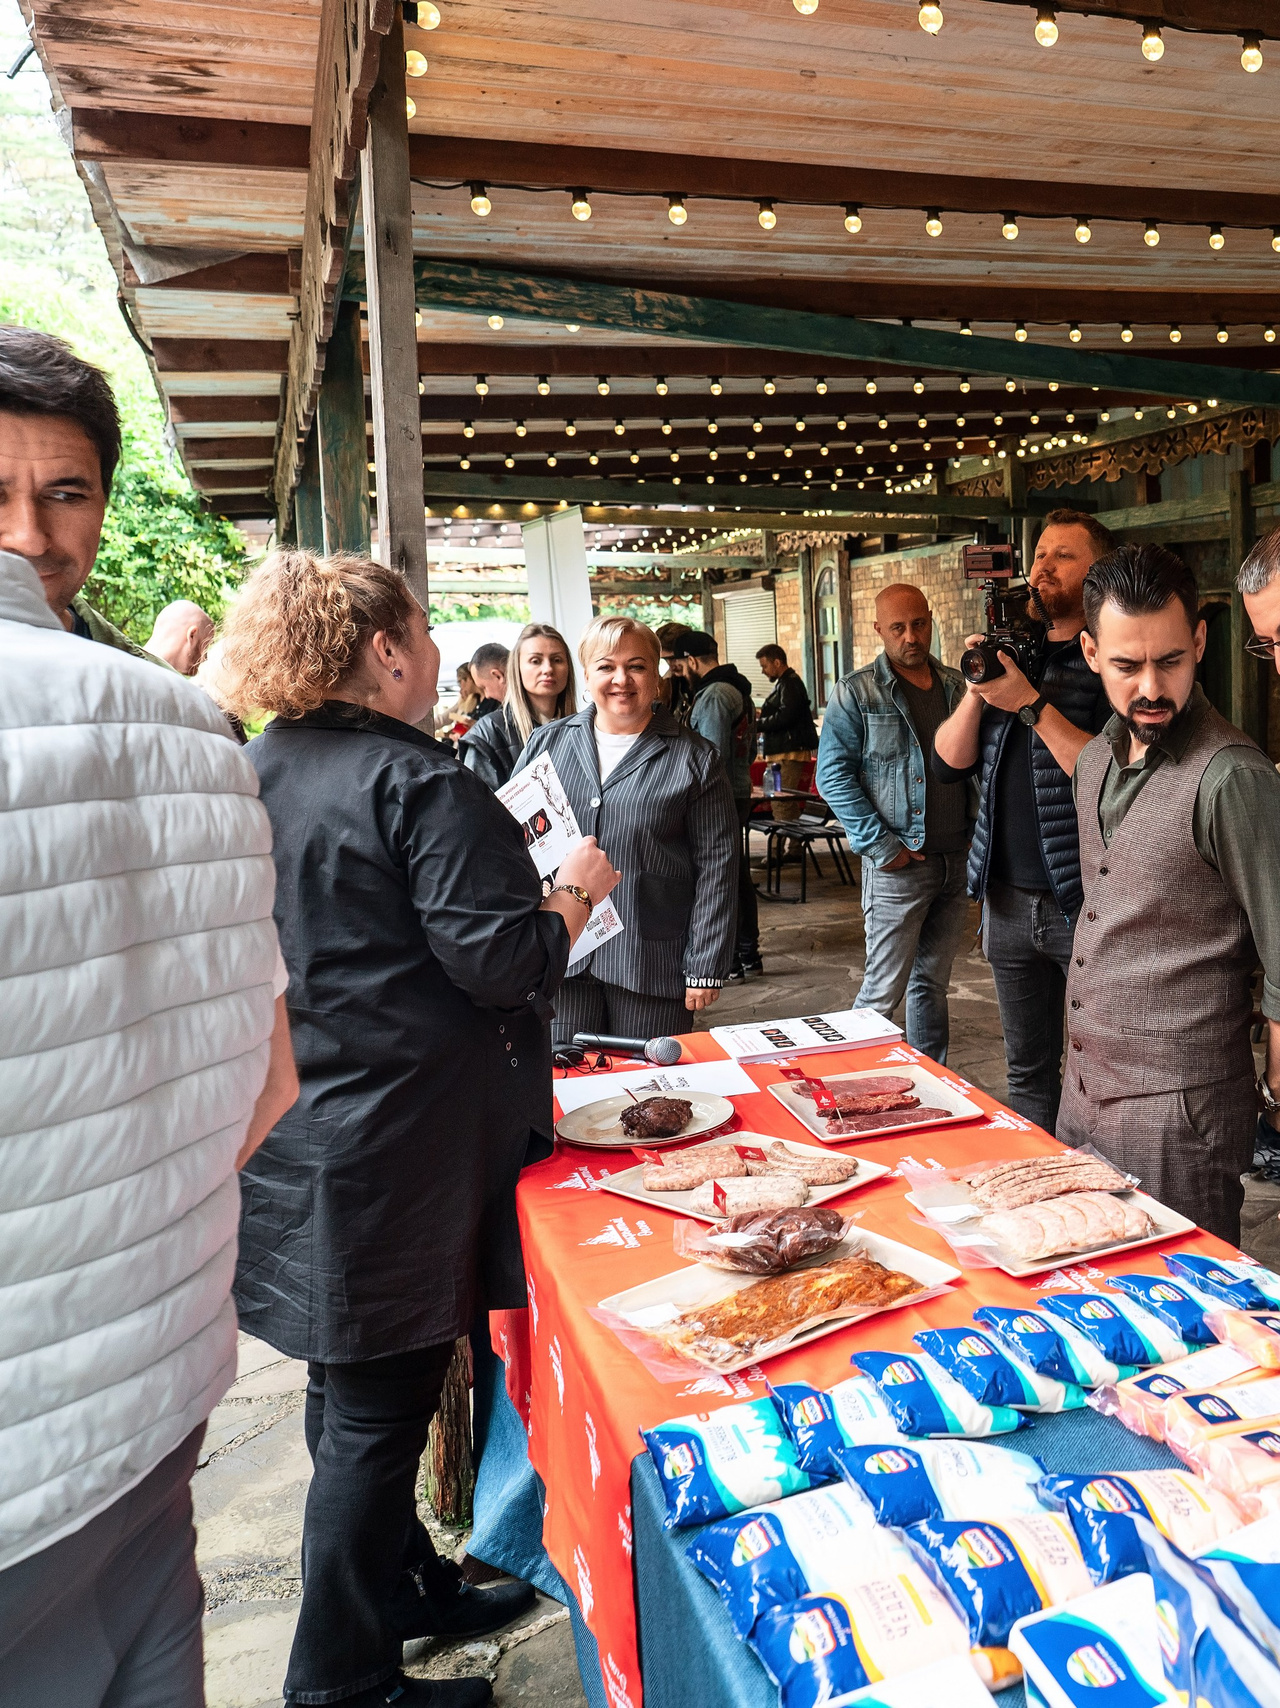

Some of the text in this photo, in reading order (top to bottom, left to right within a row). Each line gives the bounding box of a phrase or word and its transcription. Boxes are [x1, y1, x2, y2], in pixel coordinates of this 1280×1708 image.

[609, 1216, 641, 1250] Открытый
[634, 1219, 654, 1237] Огонь
[819, 1393, 833, 1420] PROFESSIONAL
[1097, 1480, 1124, 1510] Hochland
[970, 1530, 997, 1563] Hochland
